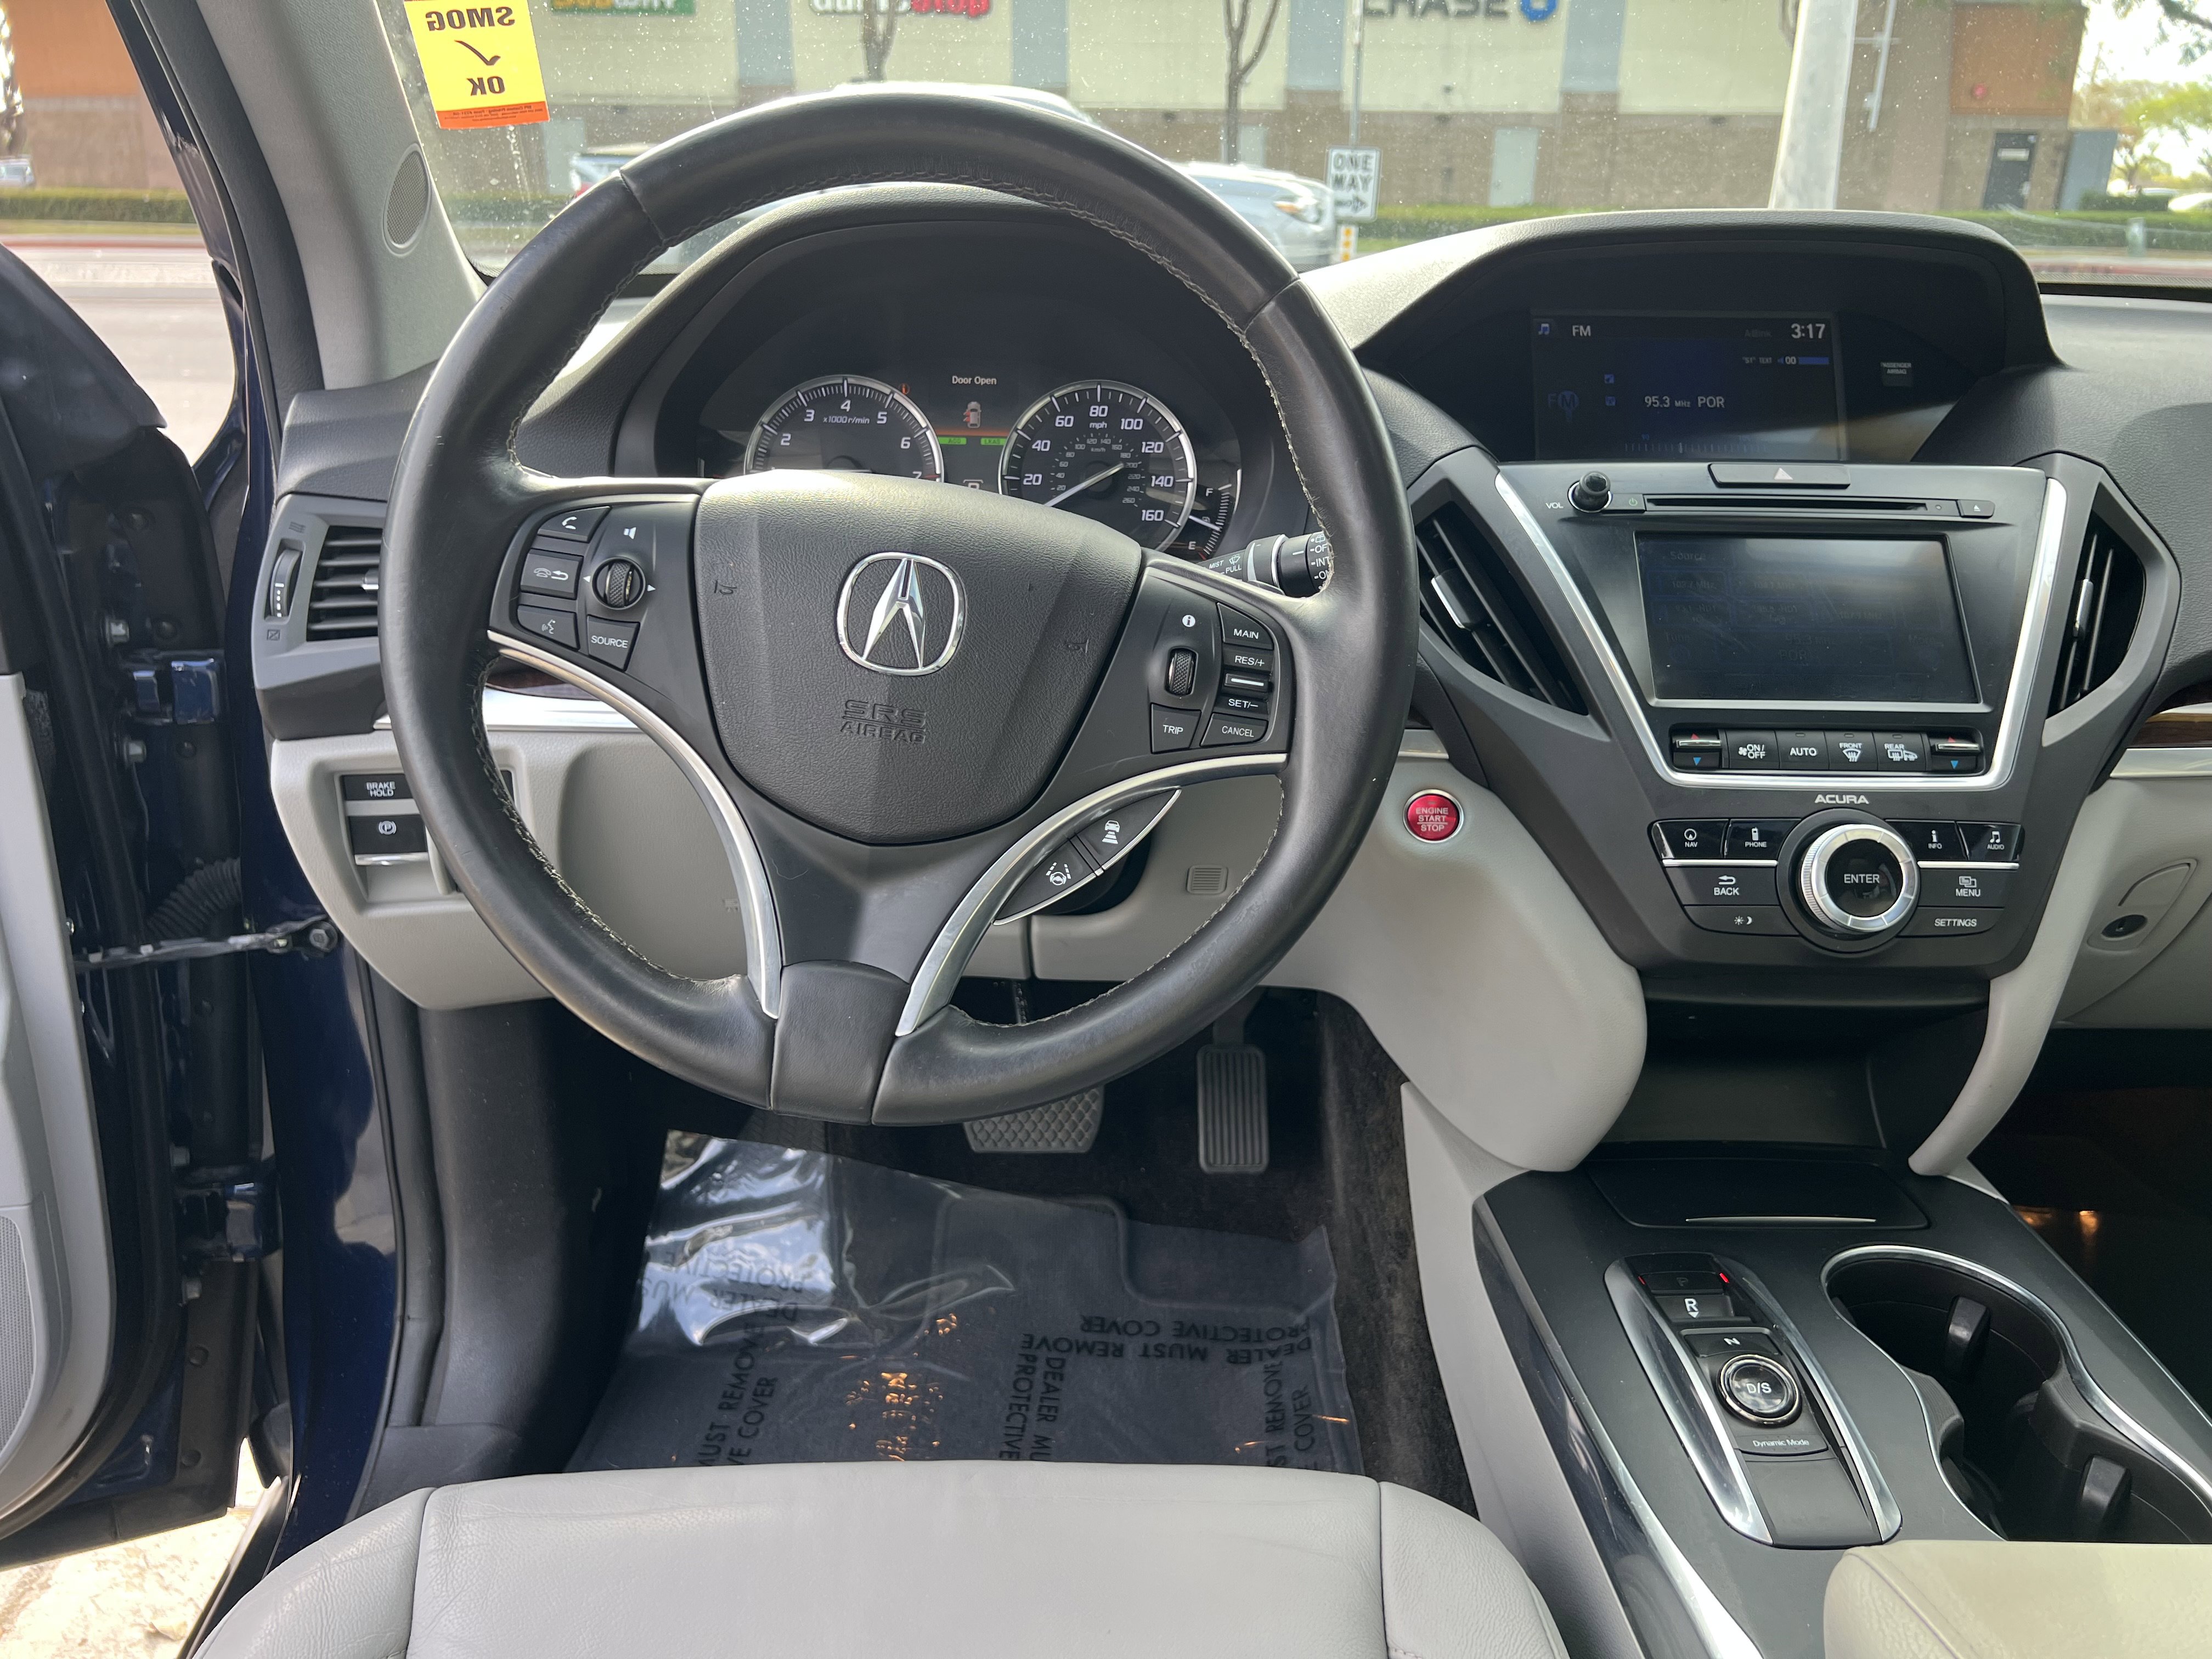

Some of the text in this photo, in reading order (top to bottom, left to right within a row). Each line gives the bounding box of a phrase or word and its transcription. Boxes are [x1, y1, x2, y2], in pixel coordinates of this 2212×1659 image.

[1334, 154, 1373, 171] ONE
[1333, 174, 1372, 193] WAY
[1572, 325, 1591, 336] FM
[1791, 323, 1826, 338] 3:17
[952, 375, 997, 386] Door Open
[840, 400, 851, 411] 4
[1644, 396, 1725, 409] 95.3 MHz POR
[804, 410, 815, 422] 3
[1089, 405, 1108, 417] 80
[877, 411, 888, 424] 5
[1055, 415, 1074, 427] 60
[1090, 421, 1107, 429] mph
[1120, 419, 1143, 430] 100
[781, 433, 791, 445] 2
[900, 437, 911, 449] 6
[1032, 440, 1051, 452] 40
[1141, 442, 1164, 453] 120
[1023, 473, 1042, 485] 20
[1151, 476, 1173, 487] 140
[1205, 488, 1213, 496] F
[1141, 510, 1164, 521] 160
[1189, 541, 1196, 550] E
[1316, 556, 1330, 567] INT
[1671, 551, 1707, 561] Source
[1209, 560, 1224, 569] MIST
[1225, 565, 1242, 574] PULL
[1233, 628, 1259, 639] MAIN
[591, 635, 628, 648] SOURCE
[1785, 634, 1812, 645] 95.3
[1234, 655, 1265, 667] RES/+
[845, 699, 927, 727] SRS
[840, 721, 926, 744] AIRBAG
[1163, 724, 1183, 735] TRIP
[1222, 725, 1254, 737] CANCEL
[1746, 744, 1765, 753] ON/
[1790, 747, 1817, 757] AUTO
[1747, 751, 1766, 759] OFF
[366, 781, 396, 790] BRAKE
[1814, 794, 1869, 804] ACURA
[1844, 874, 1880, 884] ENTER
[1713, 887, 1739, 896] BACK
[1955, 889, 1981, 897] MENU
[1934, 918, 1977, 927] SETTINGS
[1676, 1277, 1689, 1286] P
[1684, 1298, 1698, 1311] R
[1080, 1316, 1311, 1343] PROTECTIVE COVER
[1724, 1338, 1740, 1346] N
[1020, 1333, 1311, 1365] DEALER MUST REMOVE
[718, 1323, 766, 1410] REMOVE
[1036, 1356, 1066, 1423] DEALER
[1746, 1382, 1771, 1395] D/S
[1263, 1359, 1286, 1434] REMOVE
[738, 1377, 778, 1439] COVER
[1000, 1352, 1038, 1459] PROTECTIVE
[1291, 1385, 1316, 1452] COVER
[1752, 1439, 1785, 1447] Dynamic
